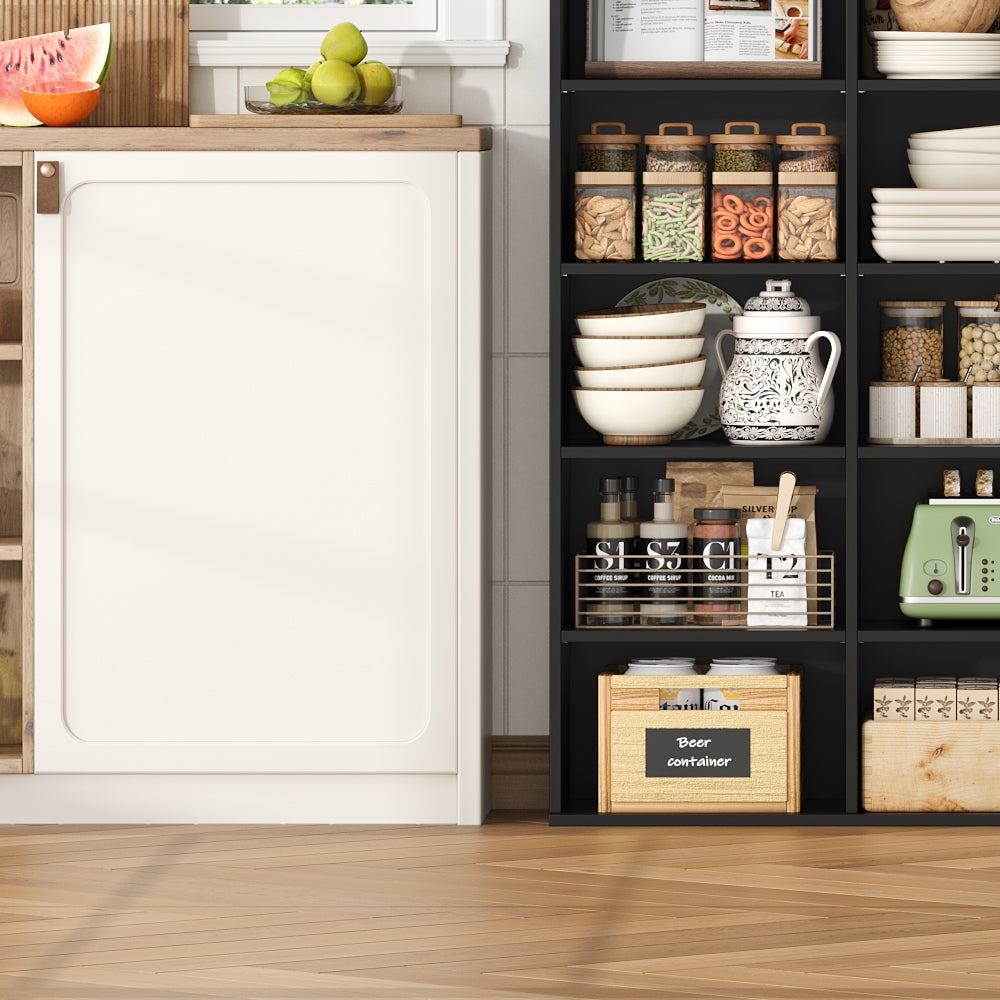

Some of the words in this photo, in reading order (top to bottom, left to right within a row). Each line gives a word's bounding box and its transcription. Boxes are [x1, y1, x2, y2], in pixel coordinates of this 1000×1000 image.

[594, 542, 626, 570] S1
[646, 542, 682, 570] S3
[702, 541, 736, 570] C1
[770, 590, 785, 598] TEA
[676, 736, 712, 748] Beer
[667, 756, 732, 767] container
